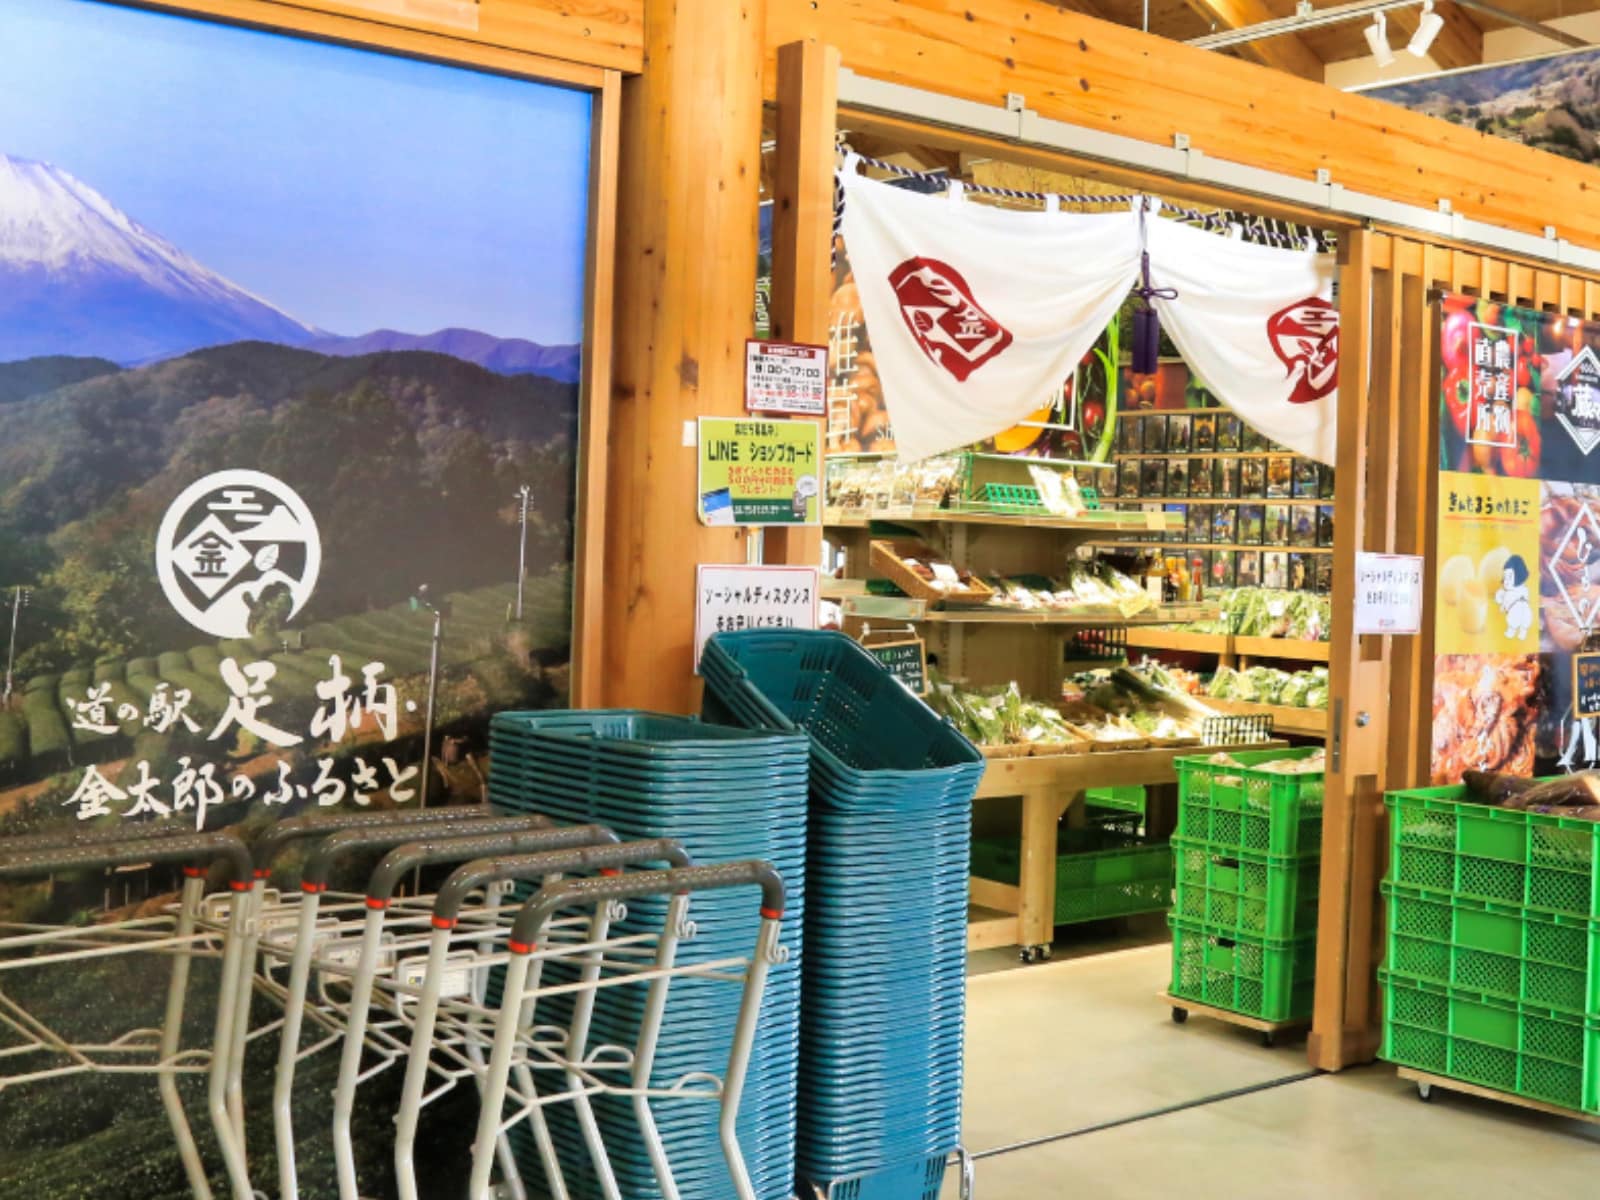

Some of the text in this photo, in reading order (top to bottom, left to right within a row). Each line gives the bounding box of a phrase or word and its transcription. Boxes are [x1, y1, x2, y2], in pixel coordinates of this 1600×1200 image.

[708, 440, 812, 463] LINE ショップカード
[187, 530, 235, 578] 金
[705, 586, 810, 605] ソーシャルディスタンス
[65, 682, 203, 735] 道の駅
[61, 757, 419, 832] 金太郎のふるさと
